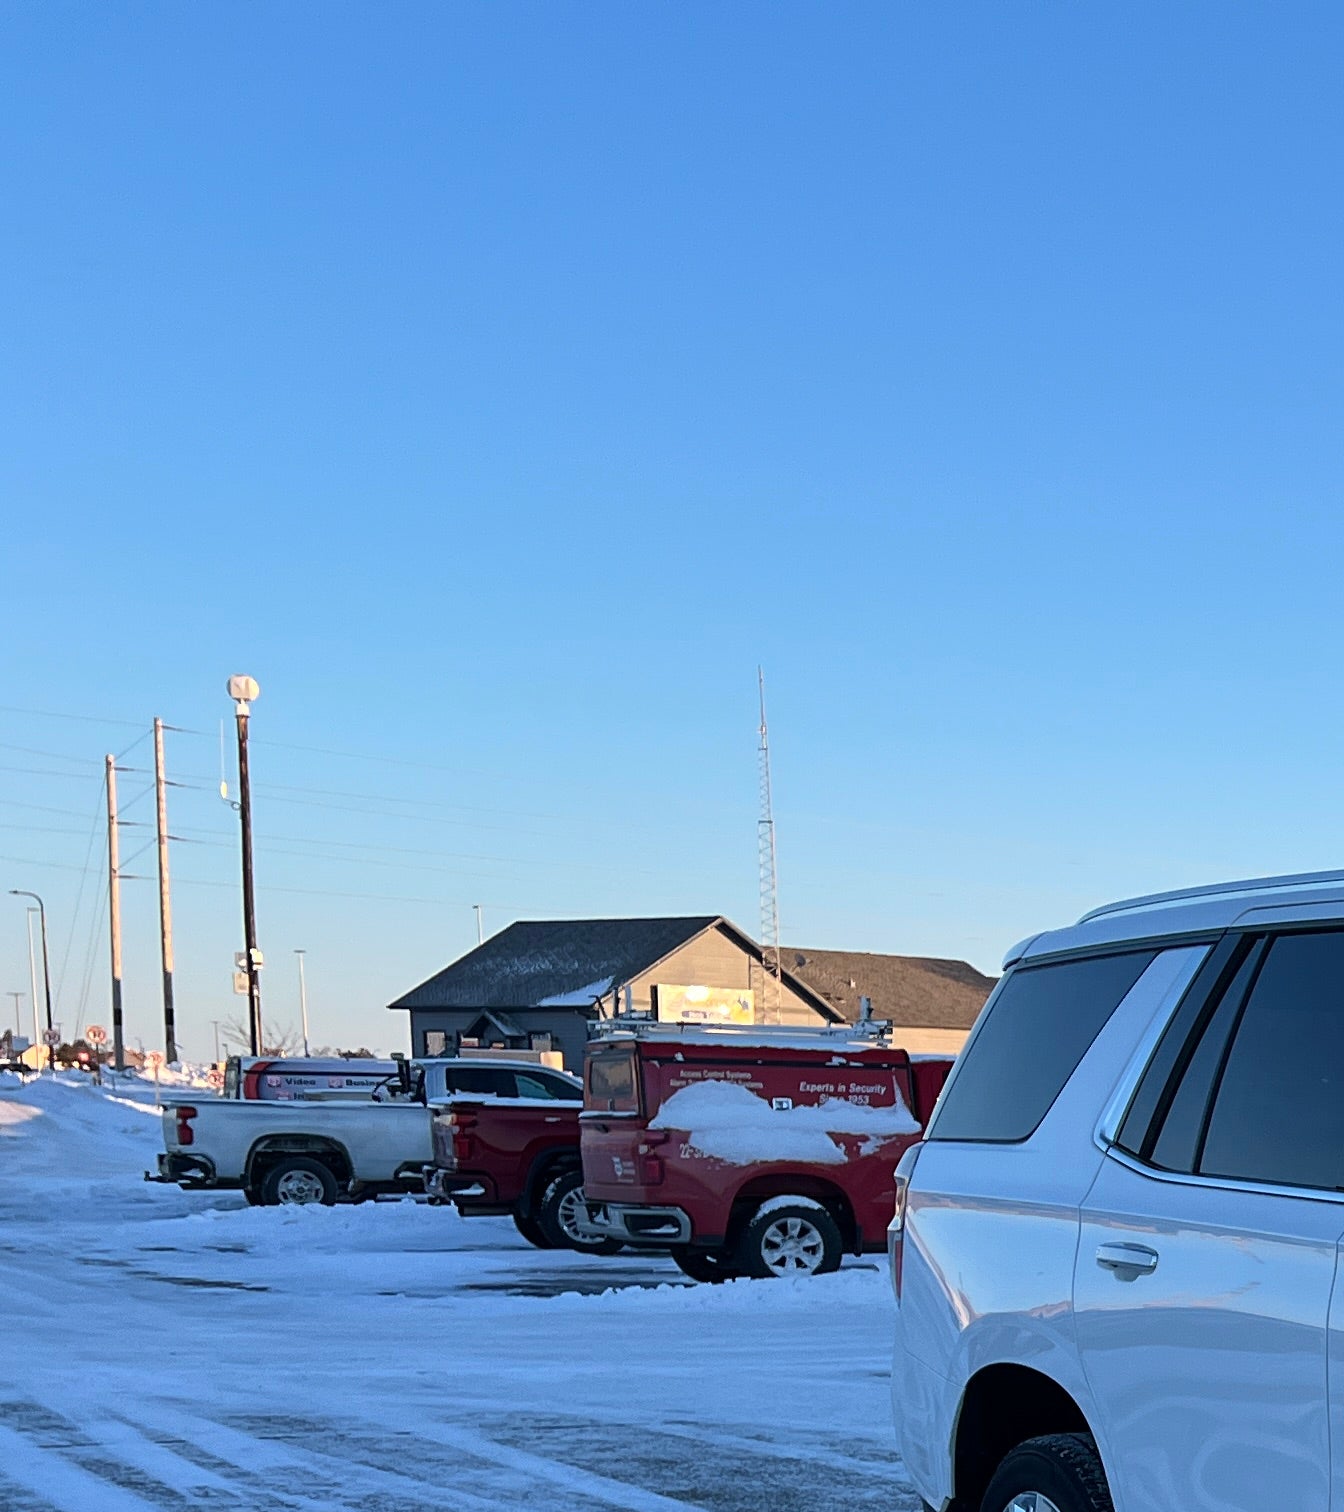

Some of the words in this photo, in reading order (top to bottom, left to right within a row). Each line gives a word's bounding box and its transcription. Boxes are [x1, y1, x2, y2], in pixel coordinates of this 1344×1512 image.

[286, 1078, 316, 1086] Video
[800, 1081, 834, 1092] Experts
[837, 1082, 846, 1092] in
[849, 1083, 887, 1095] Security
[848, 1094, 870, 1104] 1953
